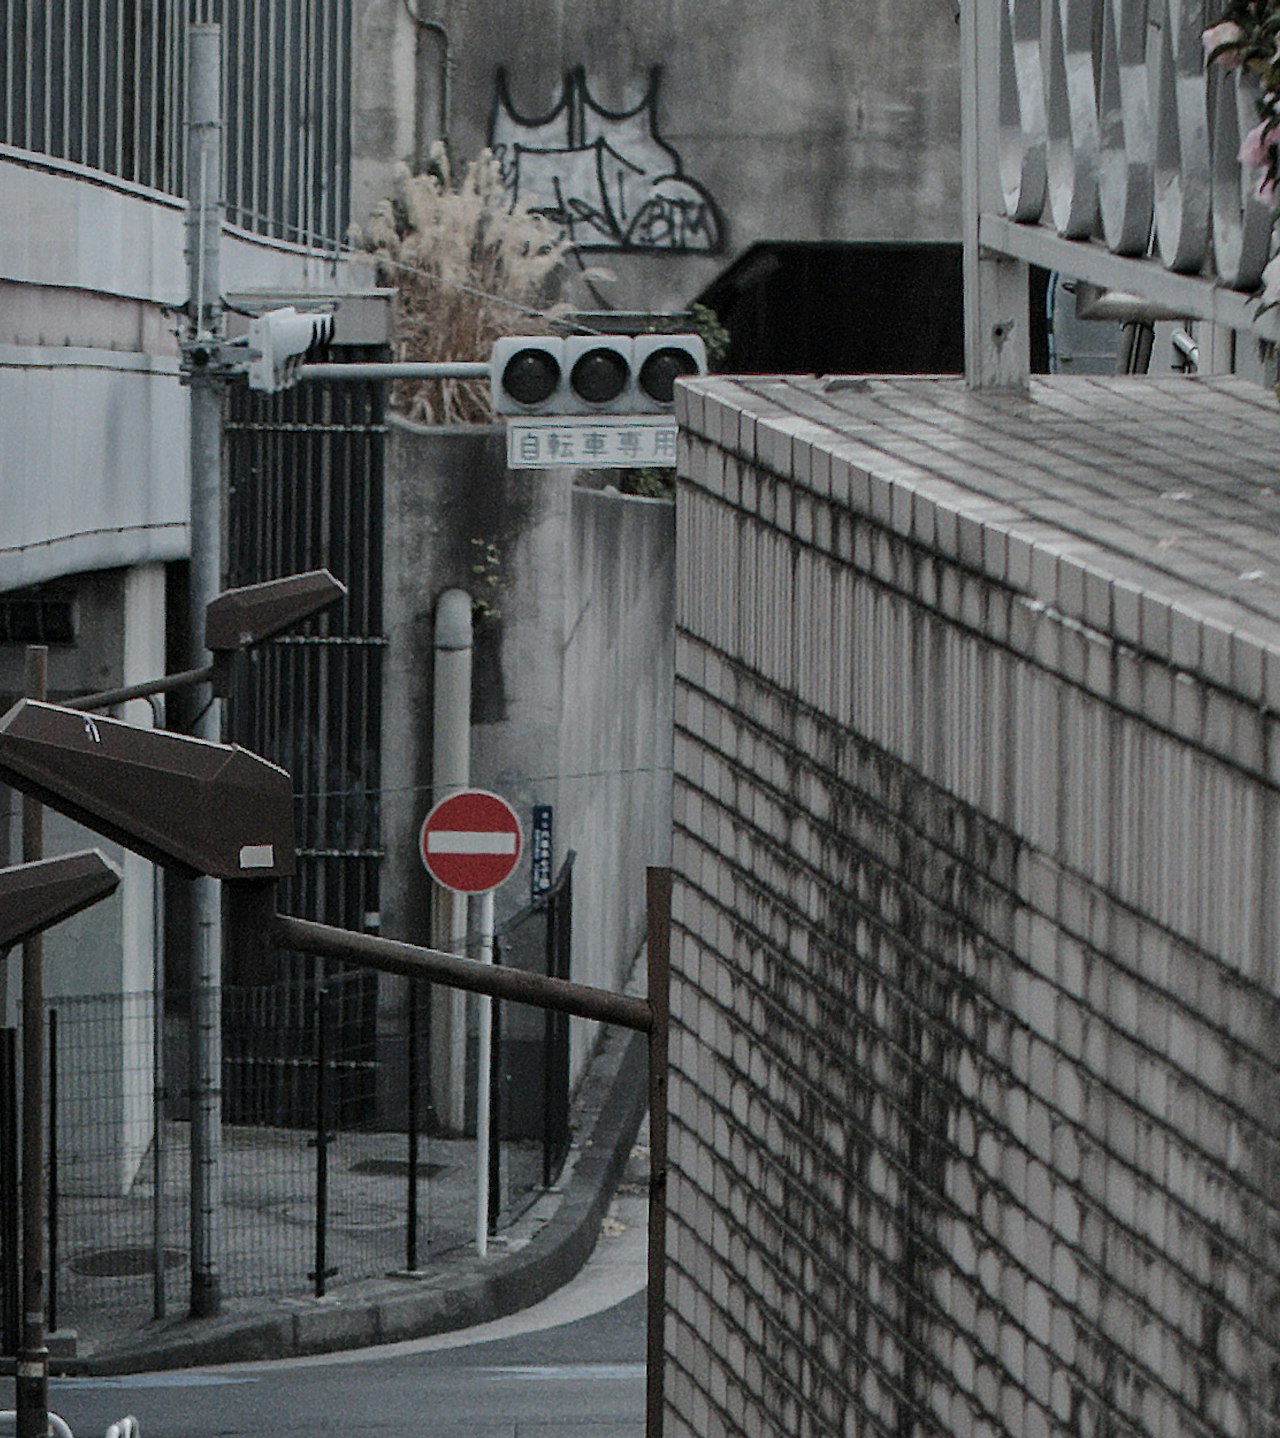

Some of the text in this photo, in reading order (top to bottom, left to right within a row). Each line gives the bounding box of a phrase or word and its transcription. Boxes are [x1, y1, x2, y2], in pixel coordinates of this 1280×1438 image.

[521, 429, 676, 461] 自転車専用
